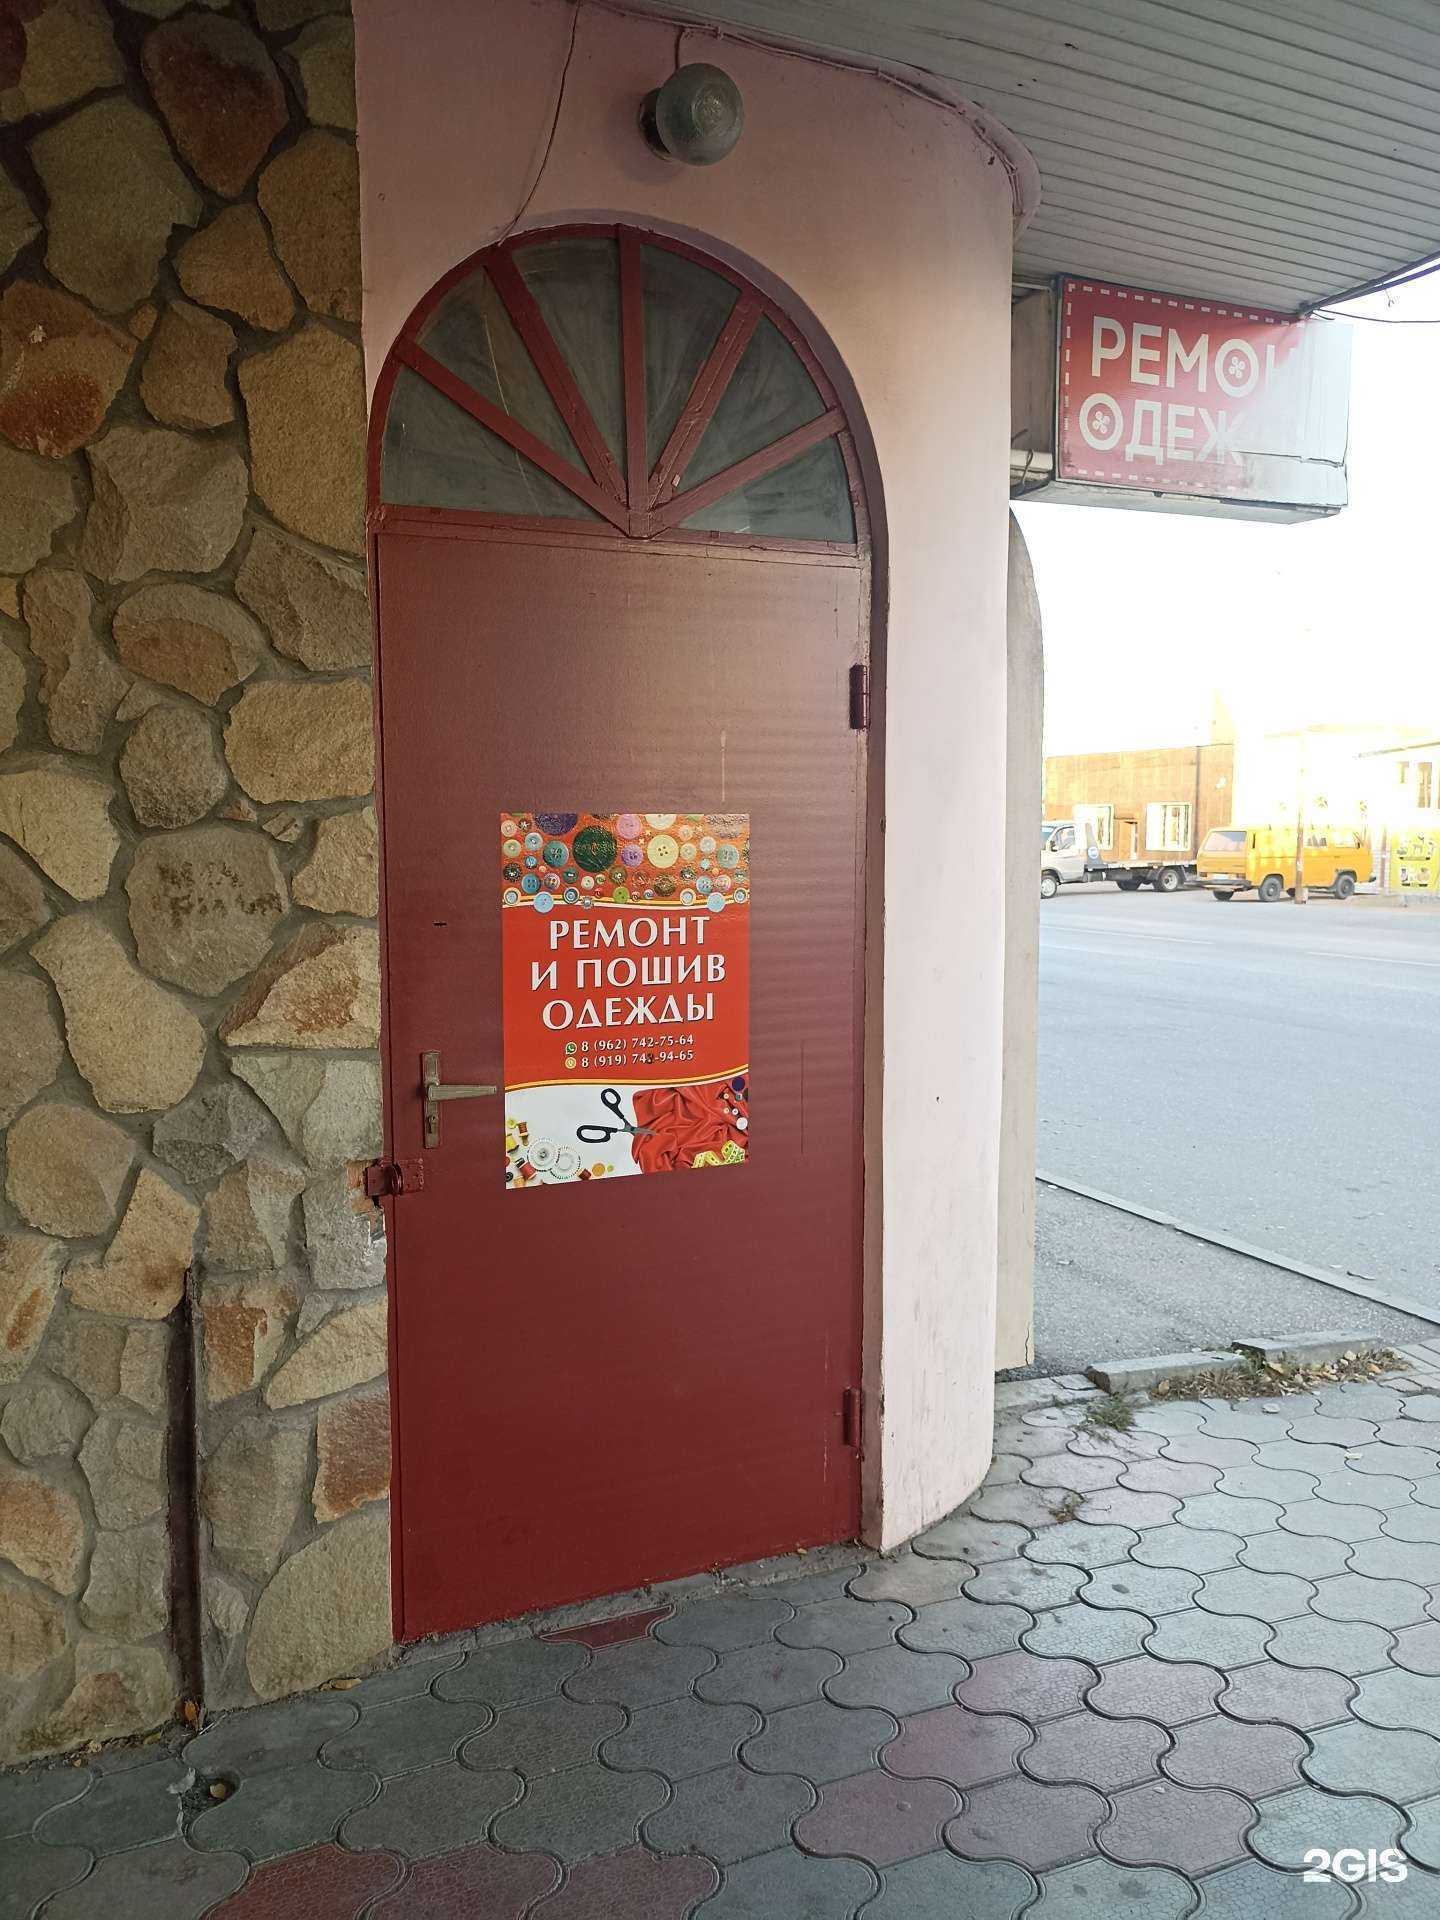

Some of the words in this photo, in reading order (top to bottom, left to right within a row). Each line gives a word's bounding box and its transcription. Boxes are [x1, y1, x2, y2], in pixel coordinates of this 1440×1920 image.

[549, 916, 711, 950] РЕМОНТ
[531, 961, 559, 991] И
[577, 955, 726, 988] ПОШИВ
[542, 992, 715, 1031] ОДЕЖДЫ
[581, 1041, 589, 1052] 8
[594, 1038, 627, 1052] (962)
[631, 1034, 694, 1049] 742-75-64
[581, 1057, 589, 1068] 8
[594, 1054, 627, 1068] (919)
